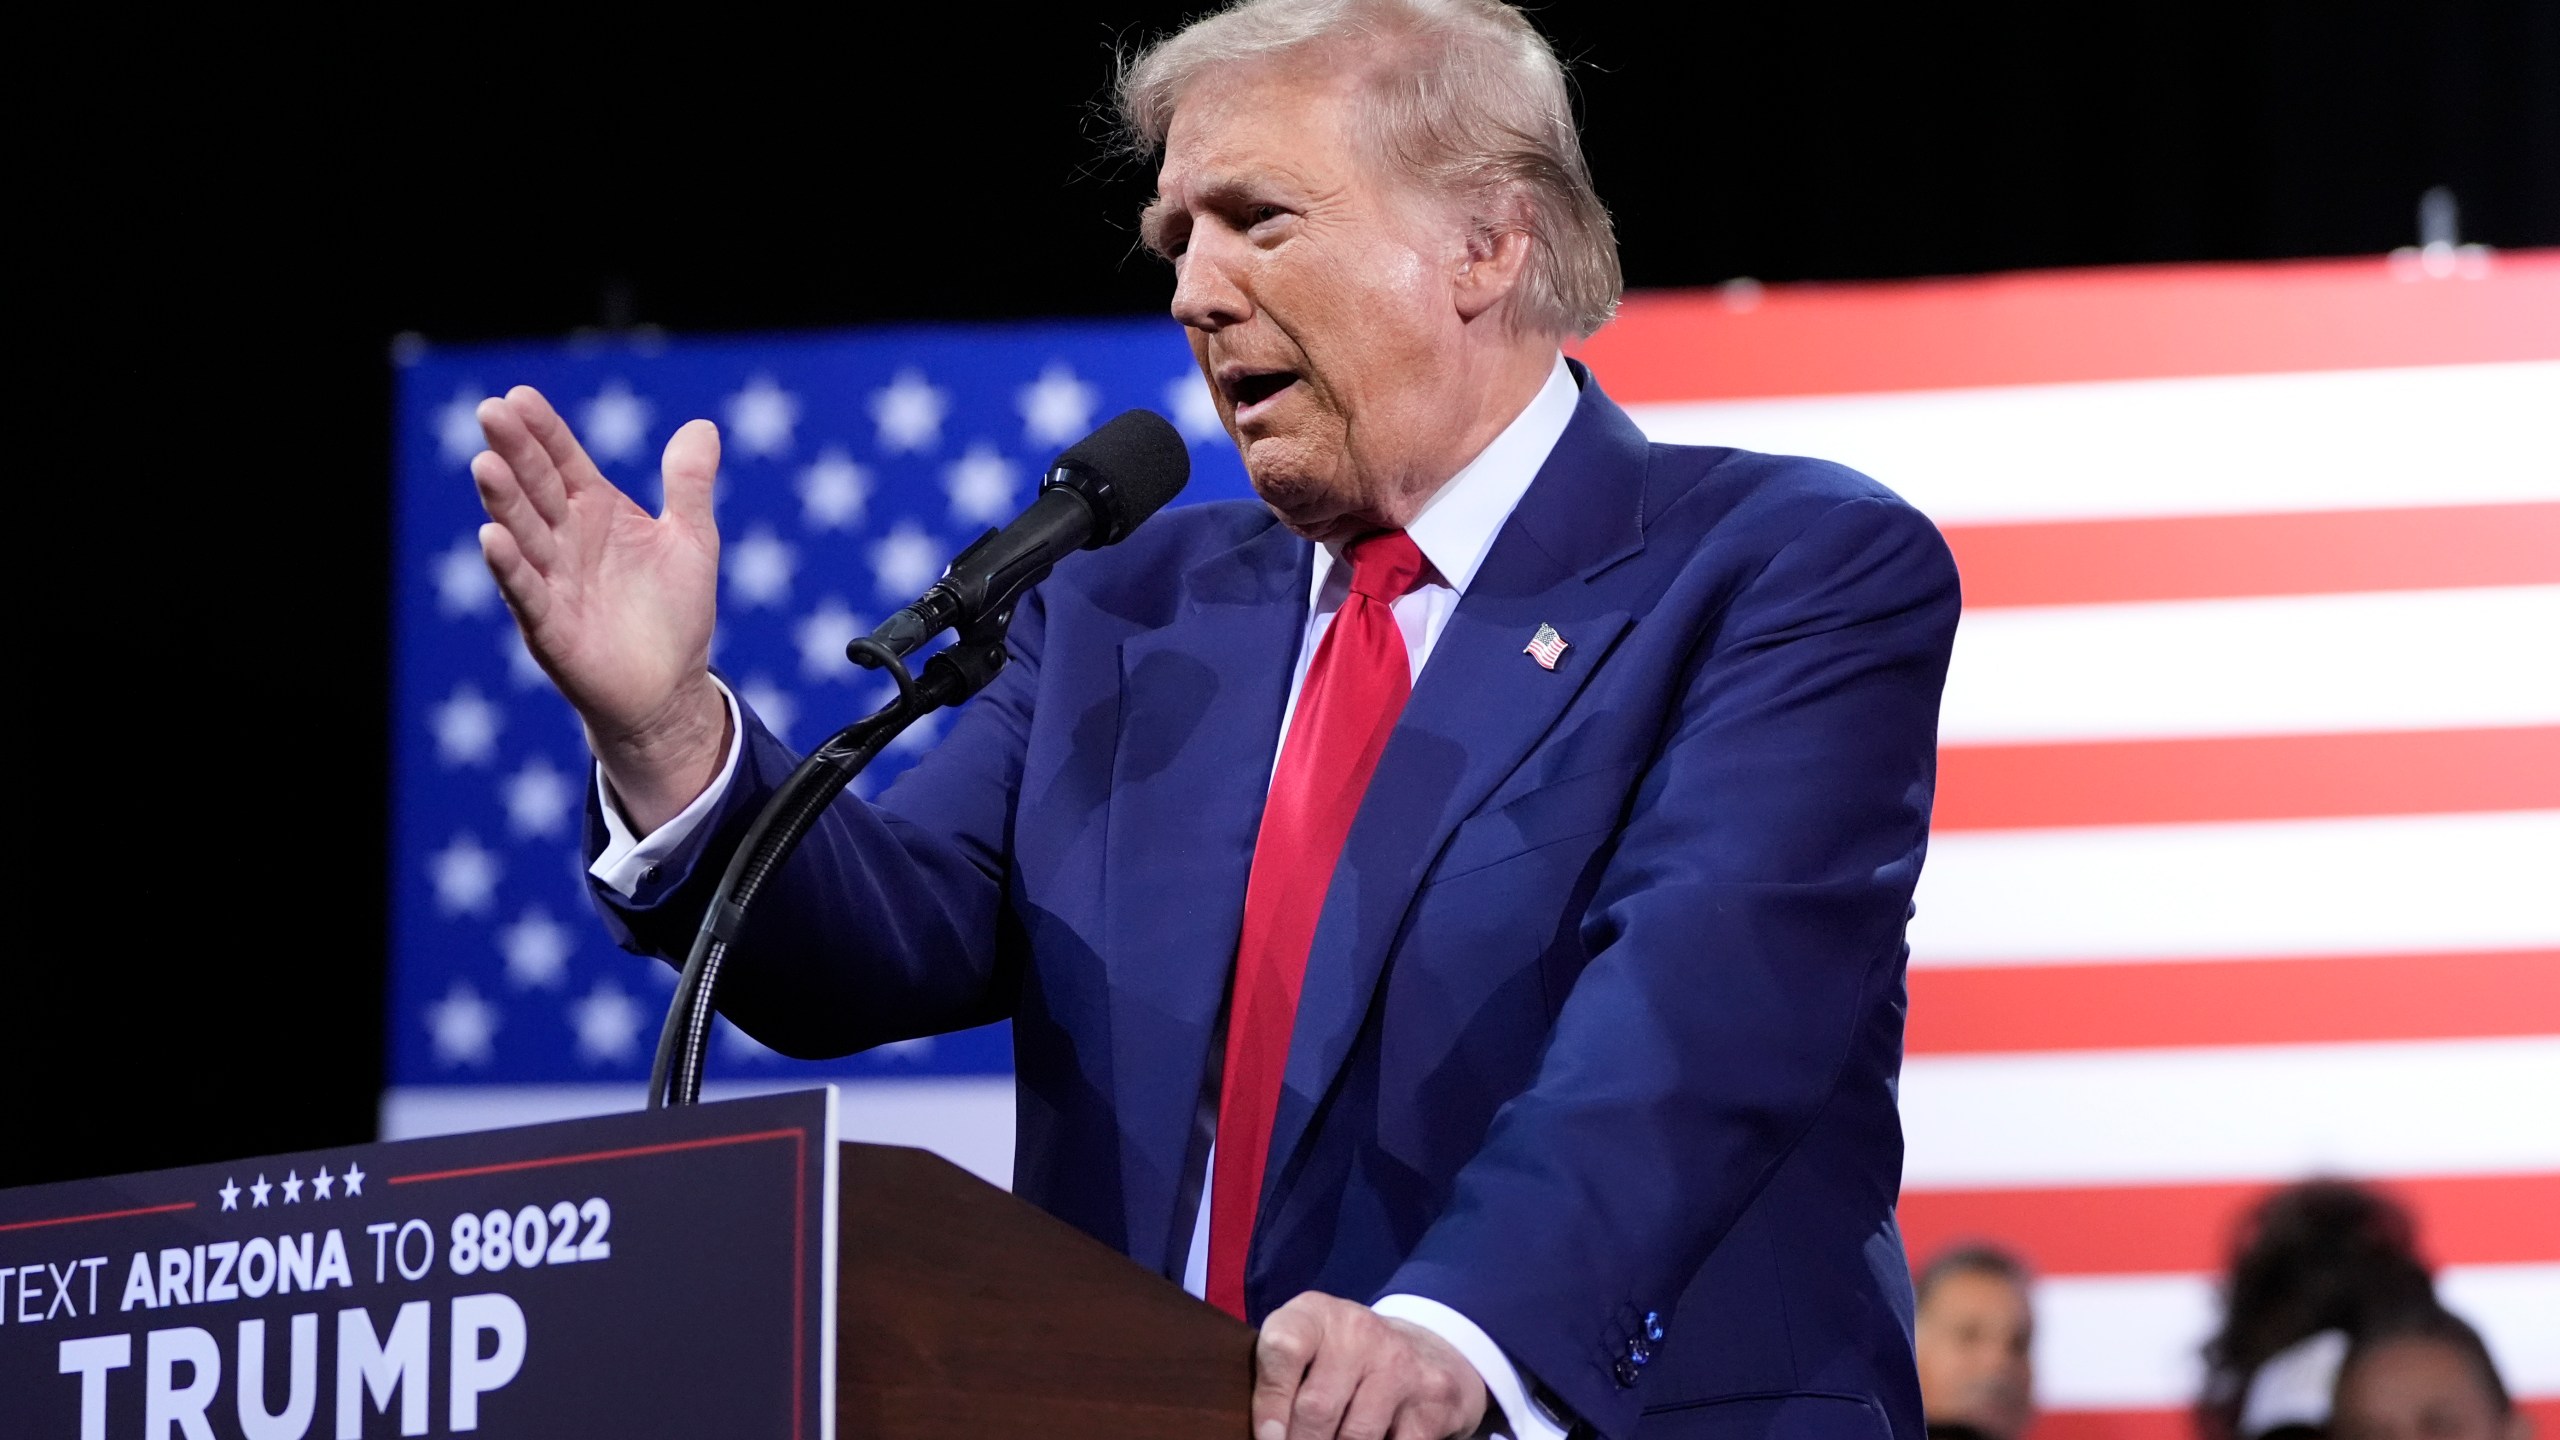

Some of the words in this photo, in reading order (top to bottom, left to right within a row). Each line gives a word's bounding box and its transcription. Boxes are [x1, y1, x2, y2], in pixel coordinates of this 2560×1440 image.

[0, 1256, 108, 1325] TEXT
[121, 1228, 352, 1311] ARIZONA
[367, 1219, 434, 1283] TO
[449, 1198, 611, 1275] 88022
[59, 1294, 527, 1440] TRUMP
